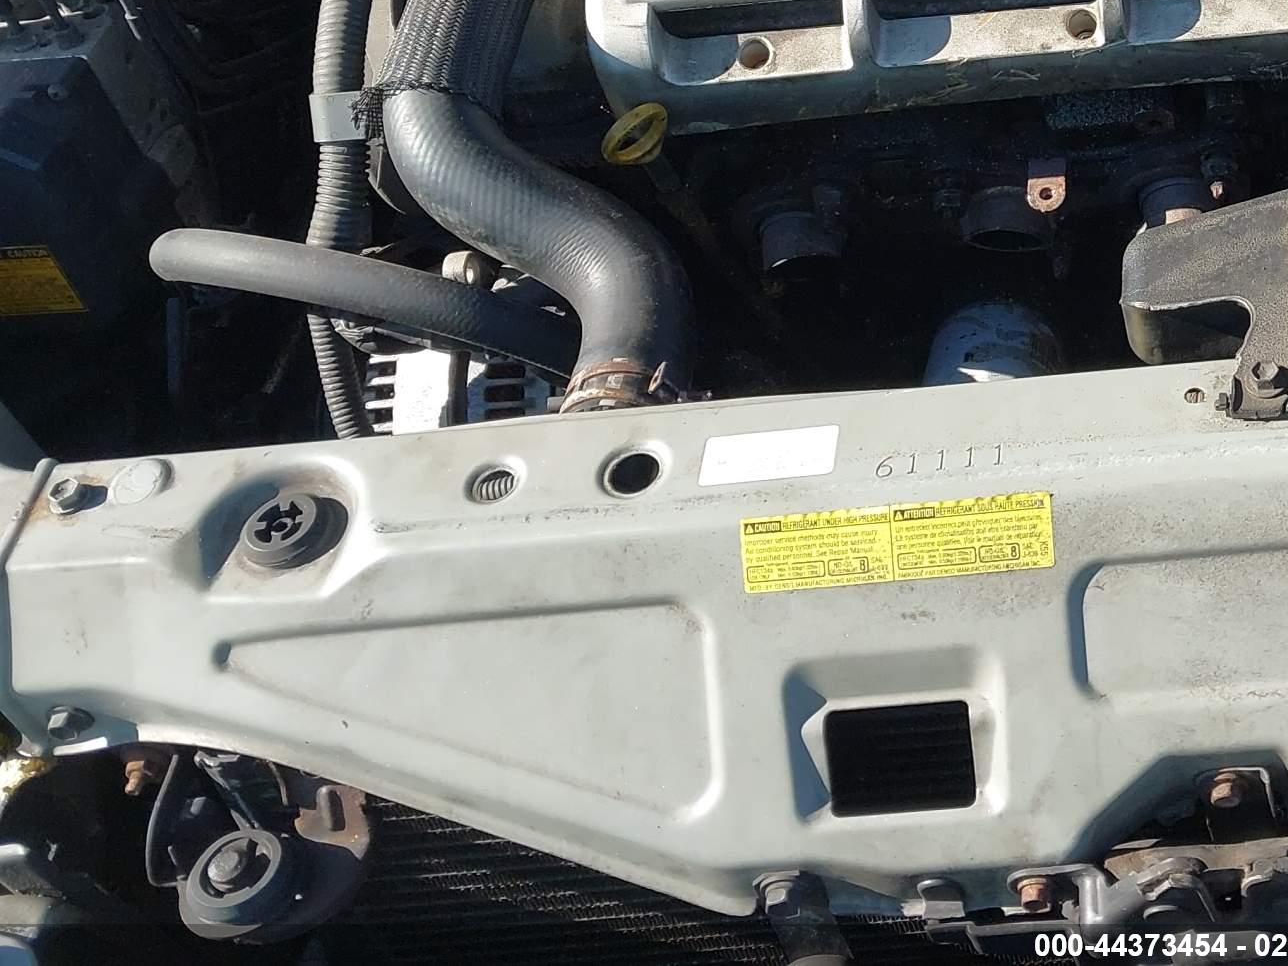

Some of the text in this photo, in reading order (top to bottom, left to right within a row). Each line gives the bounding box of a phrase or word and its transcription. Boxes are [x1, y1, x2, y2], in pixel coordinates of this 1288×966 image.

[904, 508, 933, 518] ATTENTION
[1015, 499, 1044, 508] PRESSION
[755, 513, 888, 532] CAUTION REFRIGERANT UNDER HIGH PRESSURE
[1011, 546, 1017, 558] 8
[860, 560, 866, 571] 8
